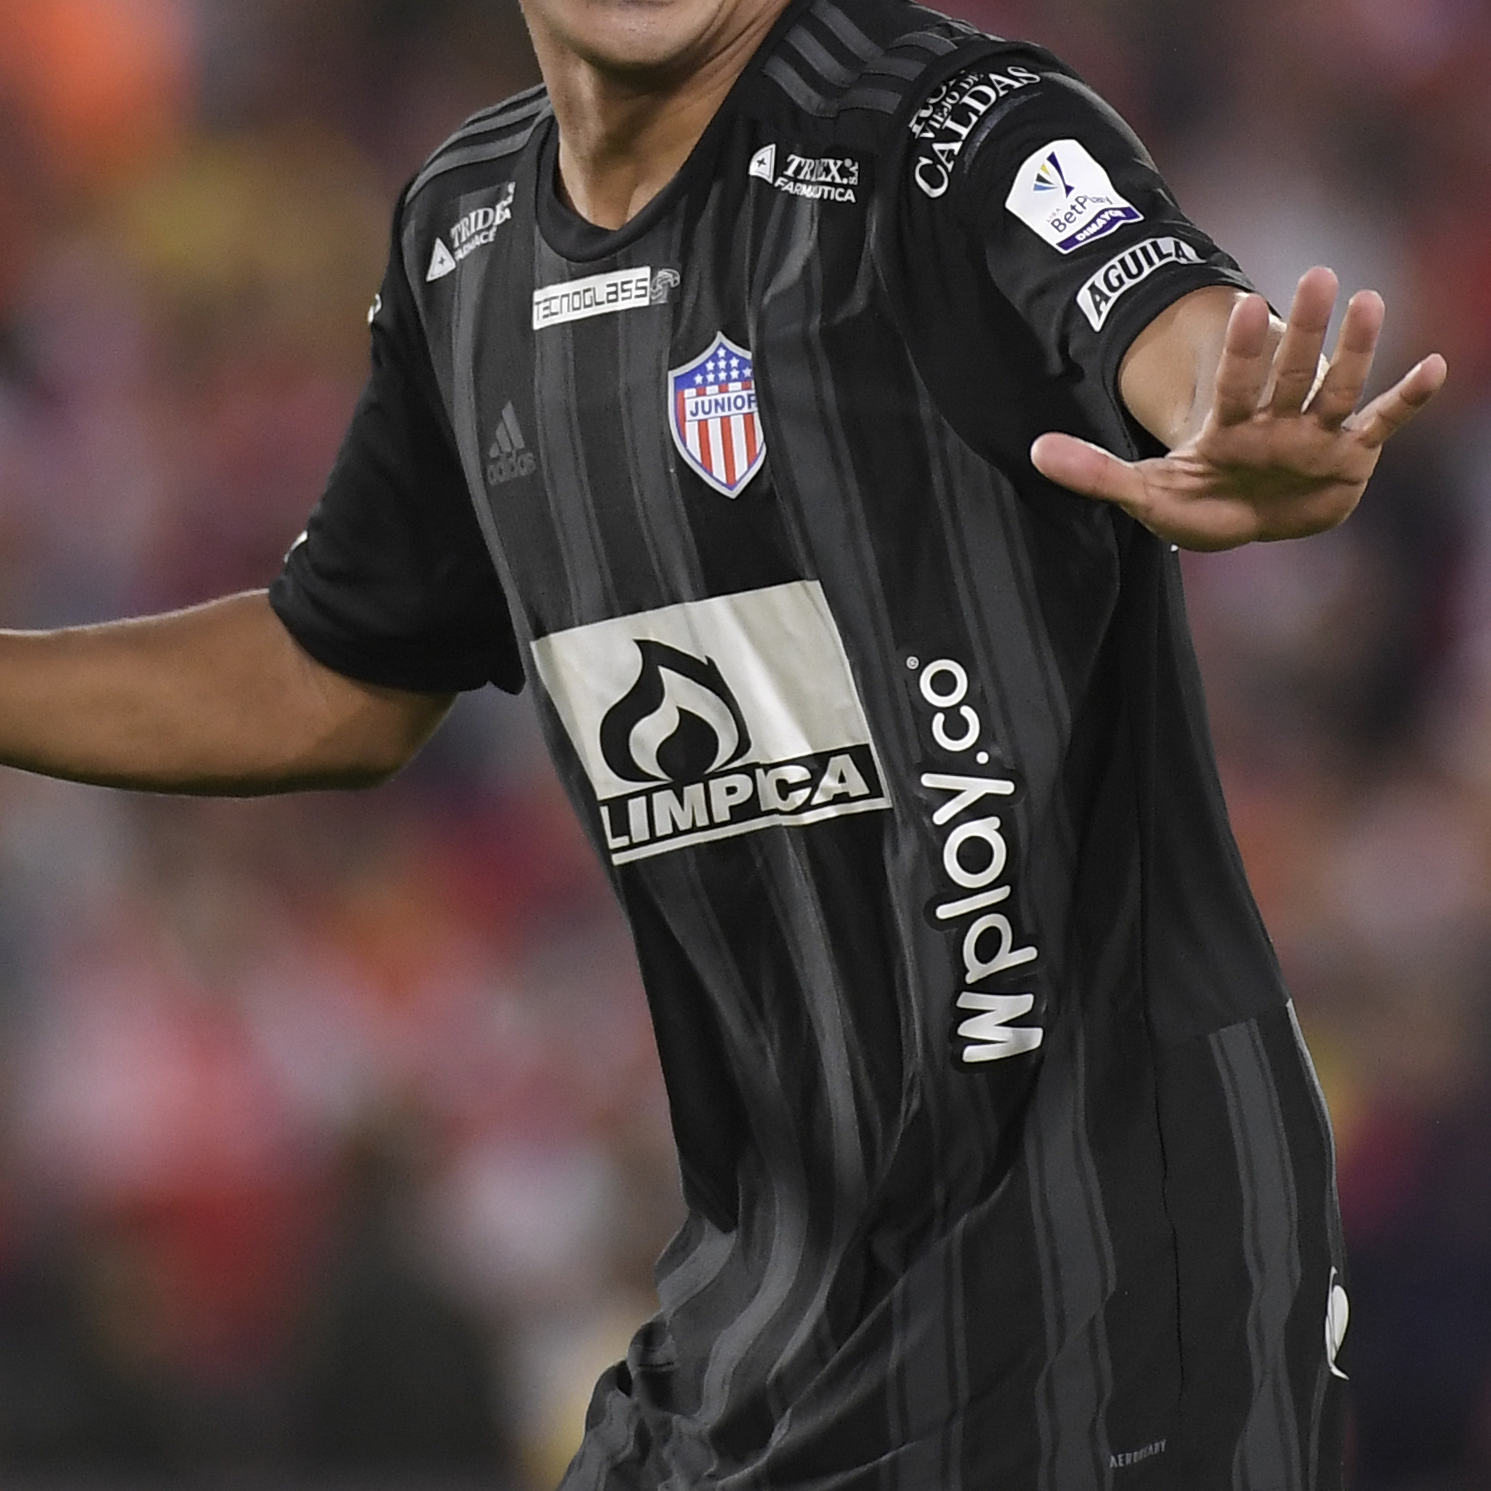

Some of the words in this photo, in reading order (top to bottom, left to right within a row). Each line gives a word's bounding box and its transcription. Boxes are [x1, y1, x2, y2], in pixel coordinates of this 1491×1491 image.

[914, 66, 1041, 200] CALDAS
[919, 91, 960, 138] VIEJO
[1087, 239, 1196, 321] AGUILA
